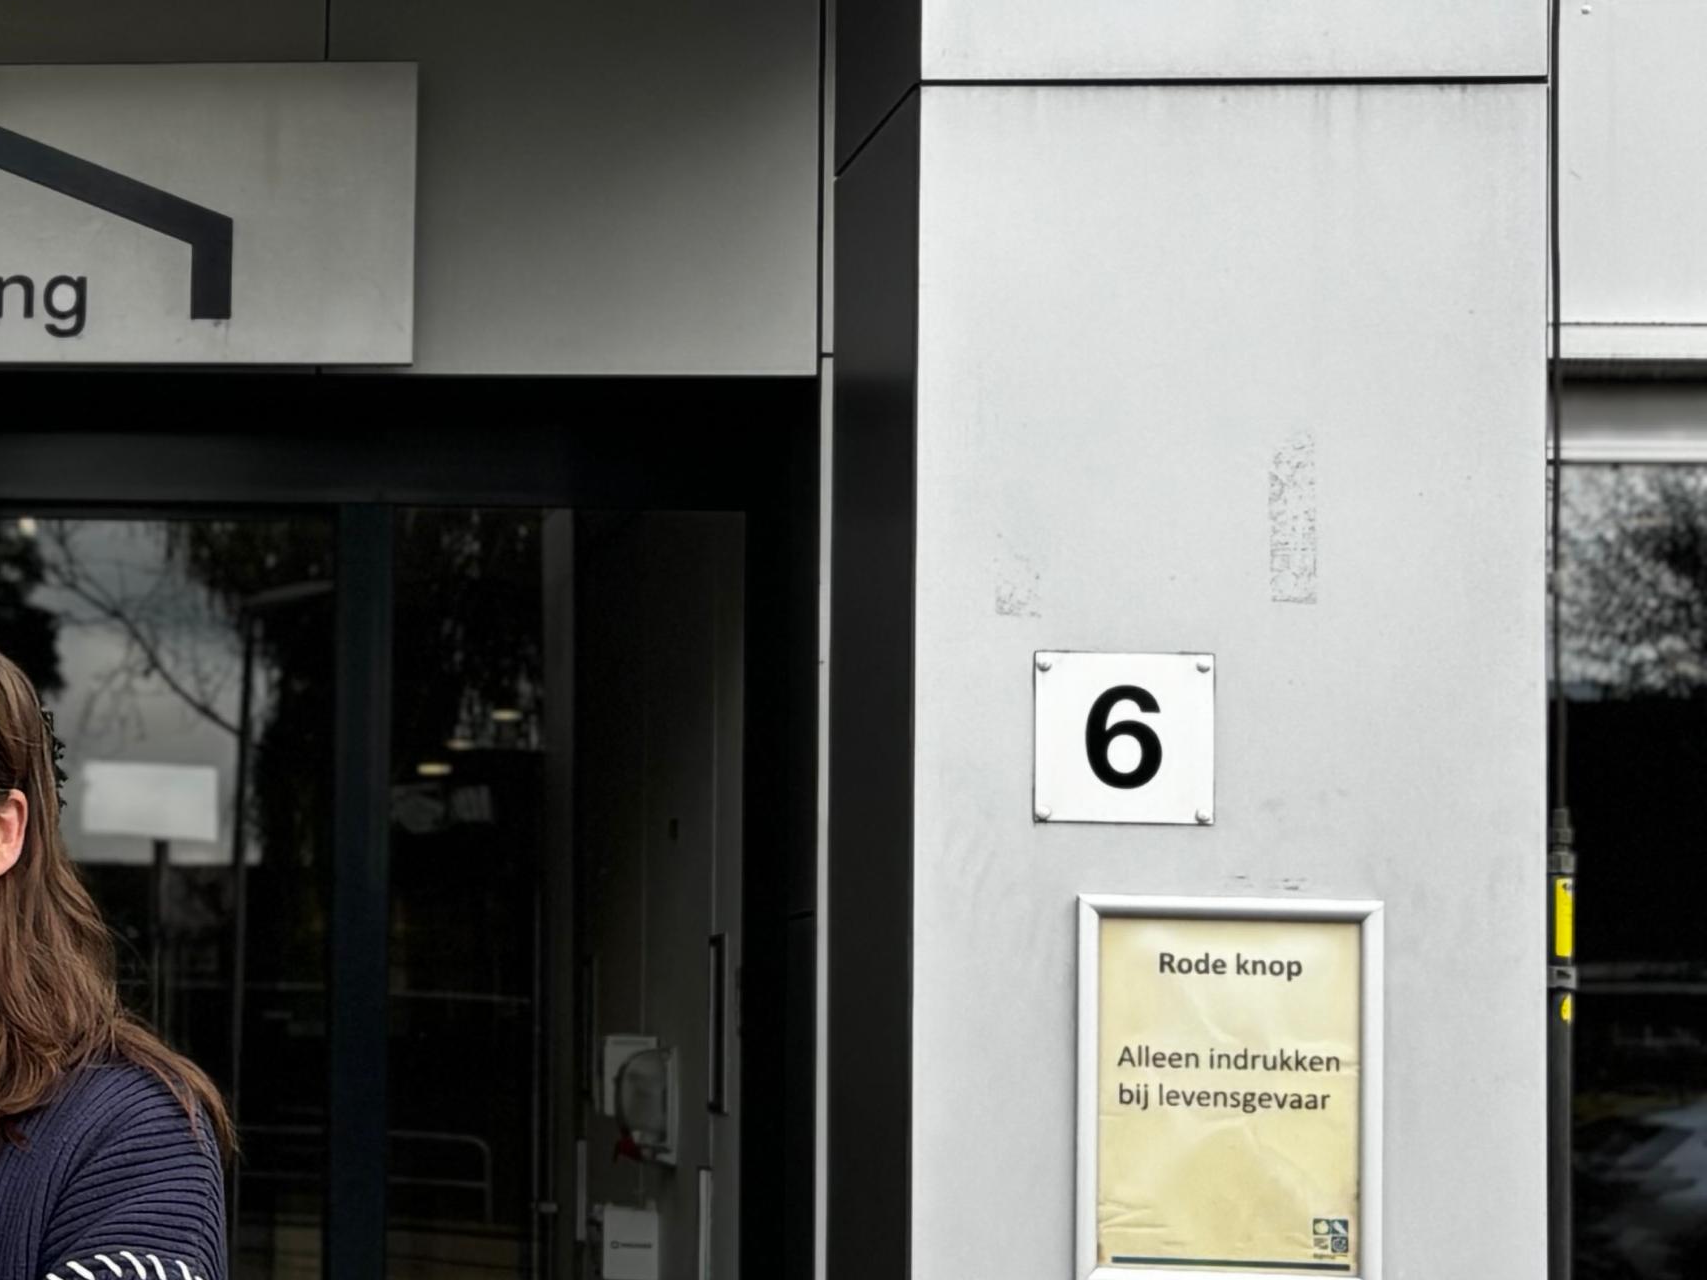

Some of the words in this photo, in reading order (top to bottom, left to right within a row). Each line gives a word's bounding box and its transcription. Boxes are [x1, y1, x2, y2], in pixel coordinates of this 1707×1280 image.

[1085, 685, 1163, 790] 6
[1159, 952, 1227, 976] Rode
[1236, 953, 1303, 983] knop
[1117, 1045, 1200, 1069] Alleen
[1209, 1045, 1341, 1073] indrukken
[1118, 1083, 1150, 1110] bij
[1158, 1084, 1331, 1114] levensgevaar
